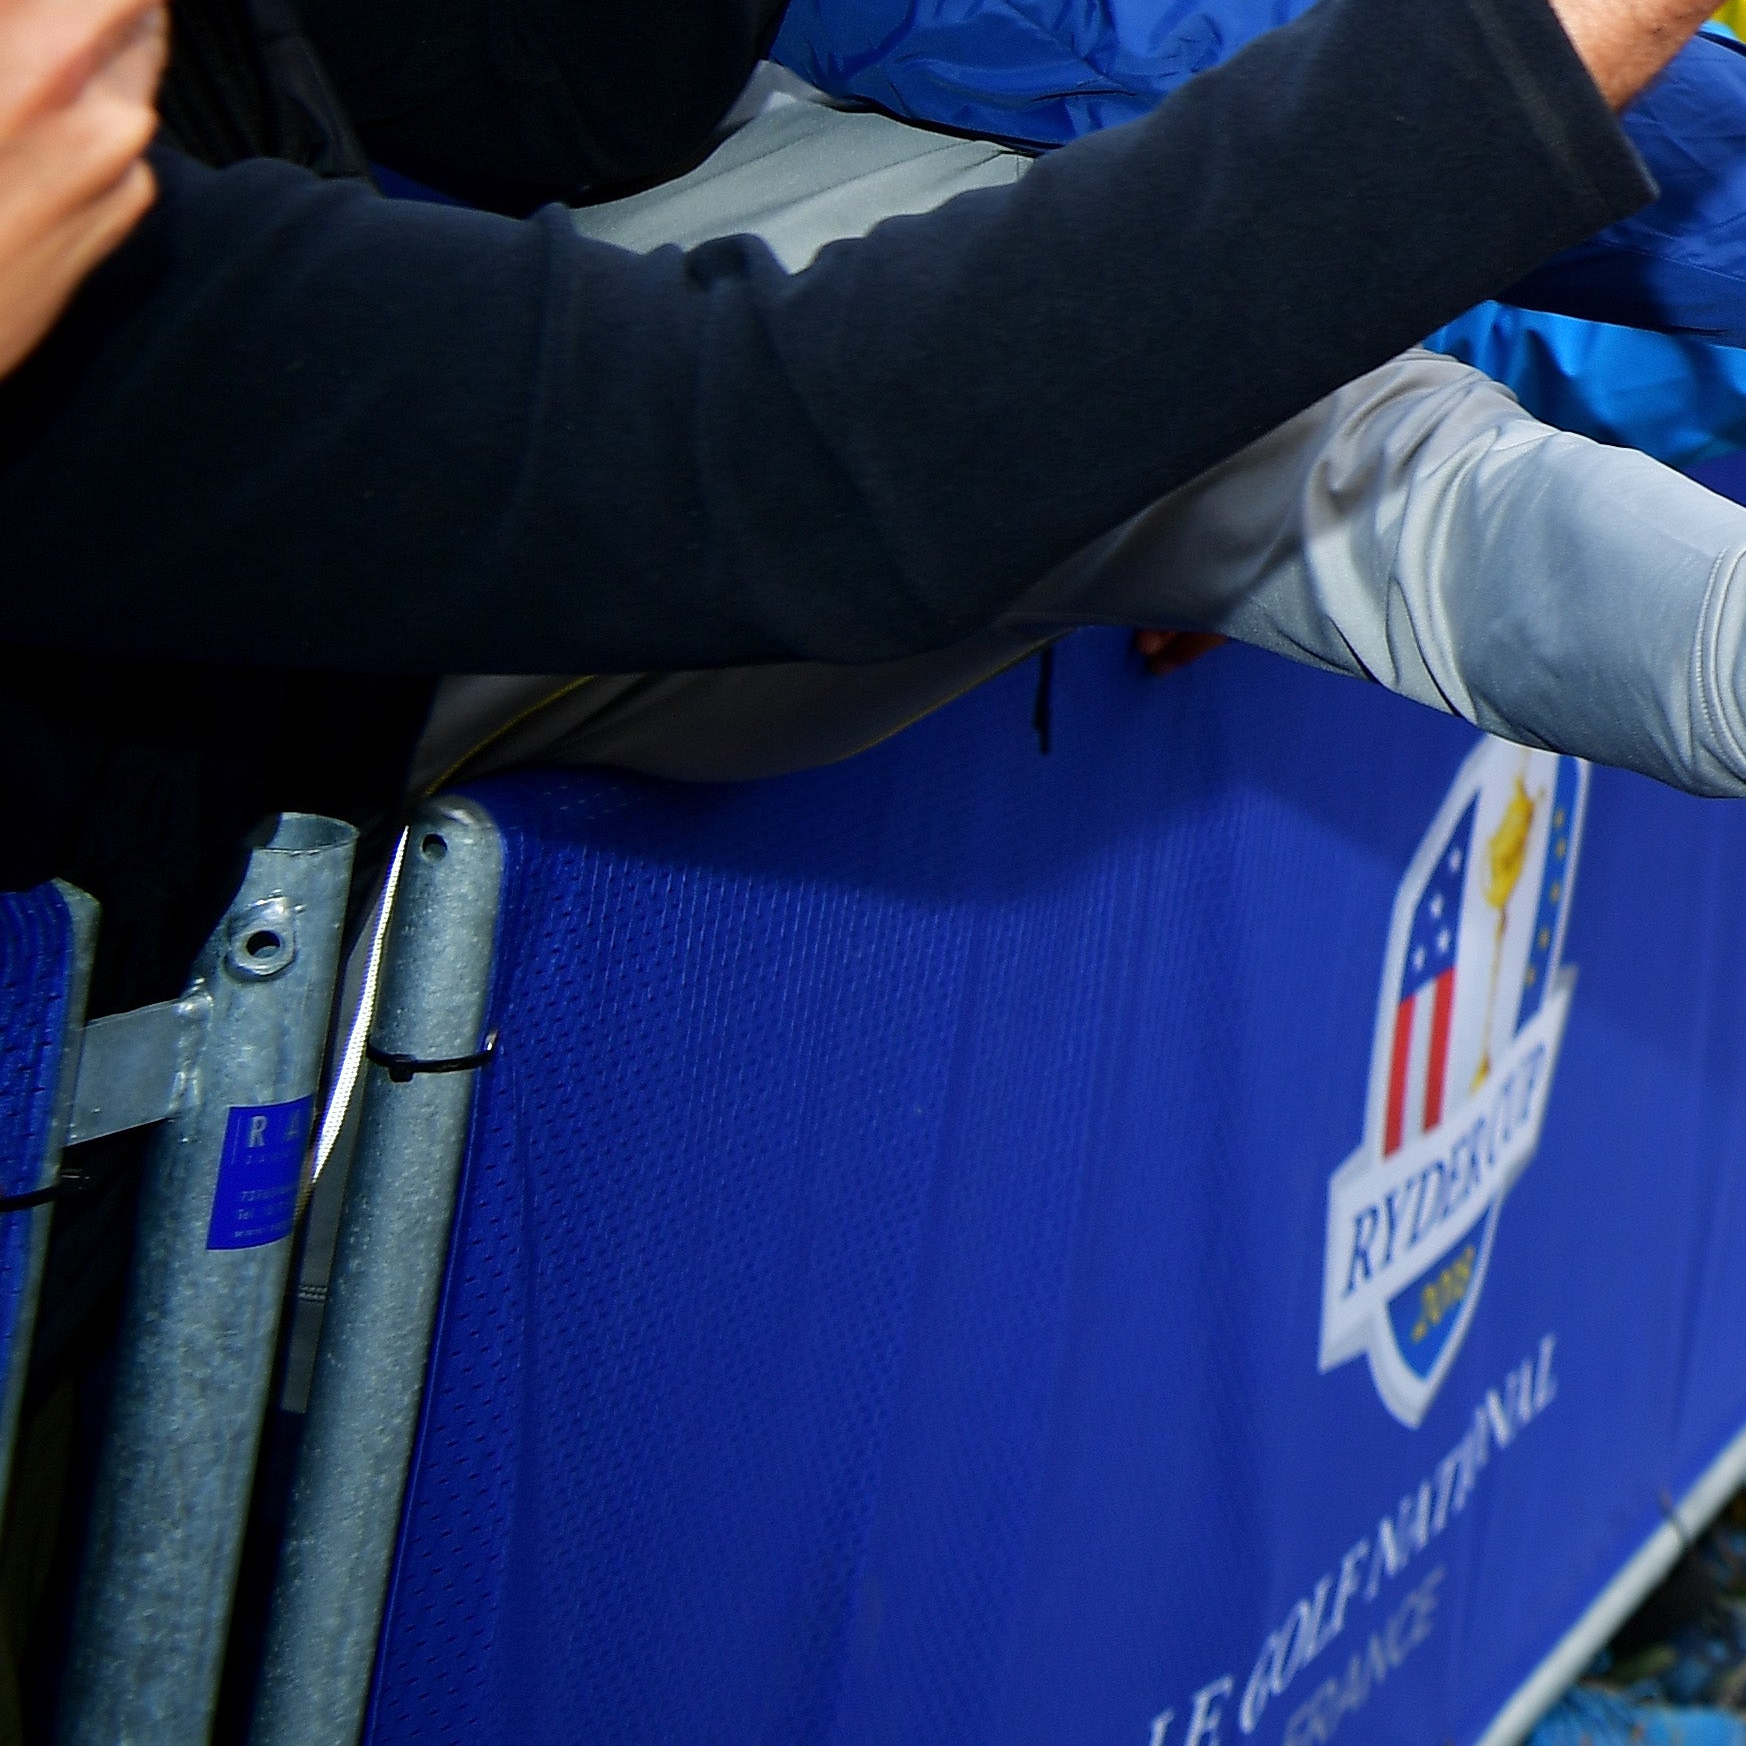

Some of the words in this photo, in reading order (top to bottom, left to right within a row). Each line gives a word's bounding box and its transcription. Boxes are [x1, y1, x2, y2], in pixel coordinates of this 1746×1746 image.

[1341, 1116, 1485, 1297] RYDER
[1240, 1540, 1369, 1734] GOLF
[1365, 1334, 1558, 1602] NATIONAL
